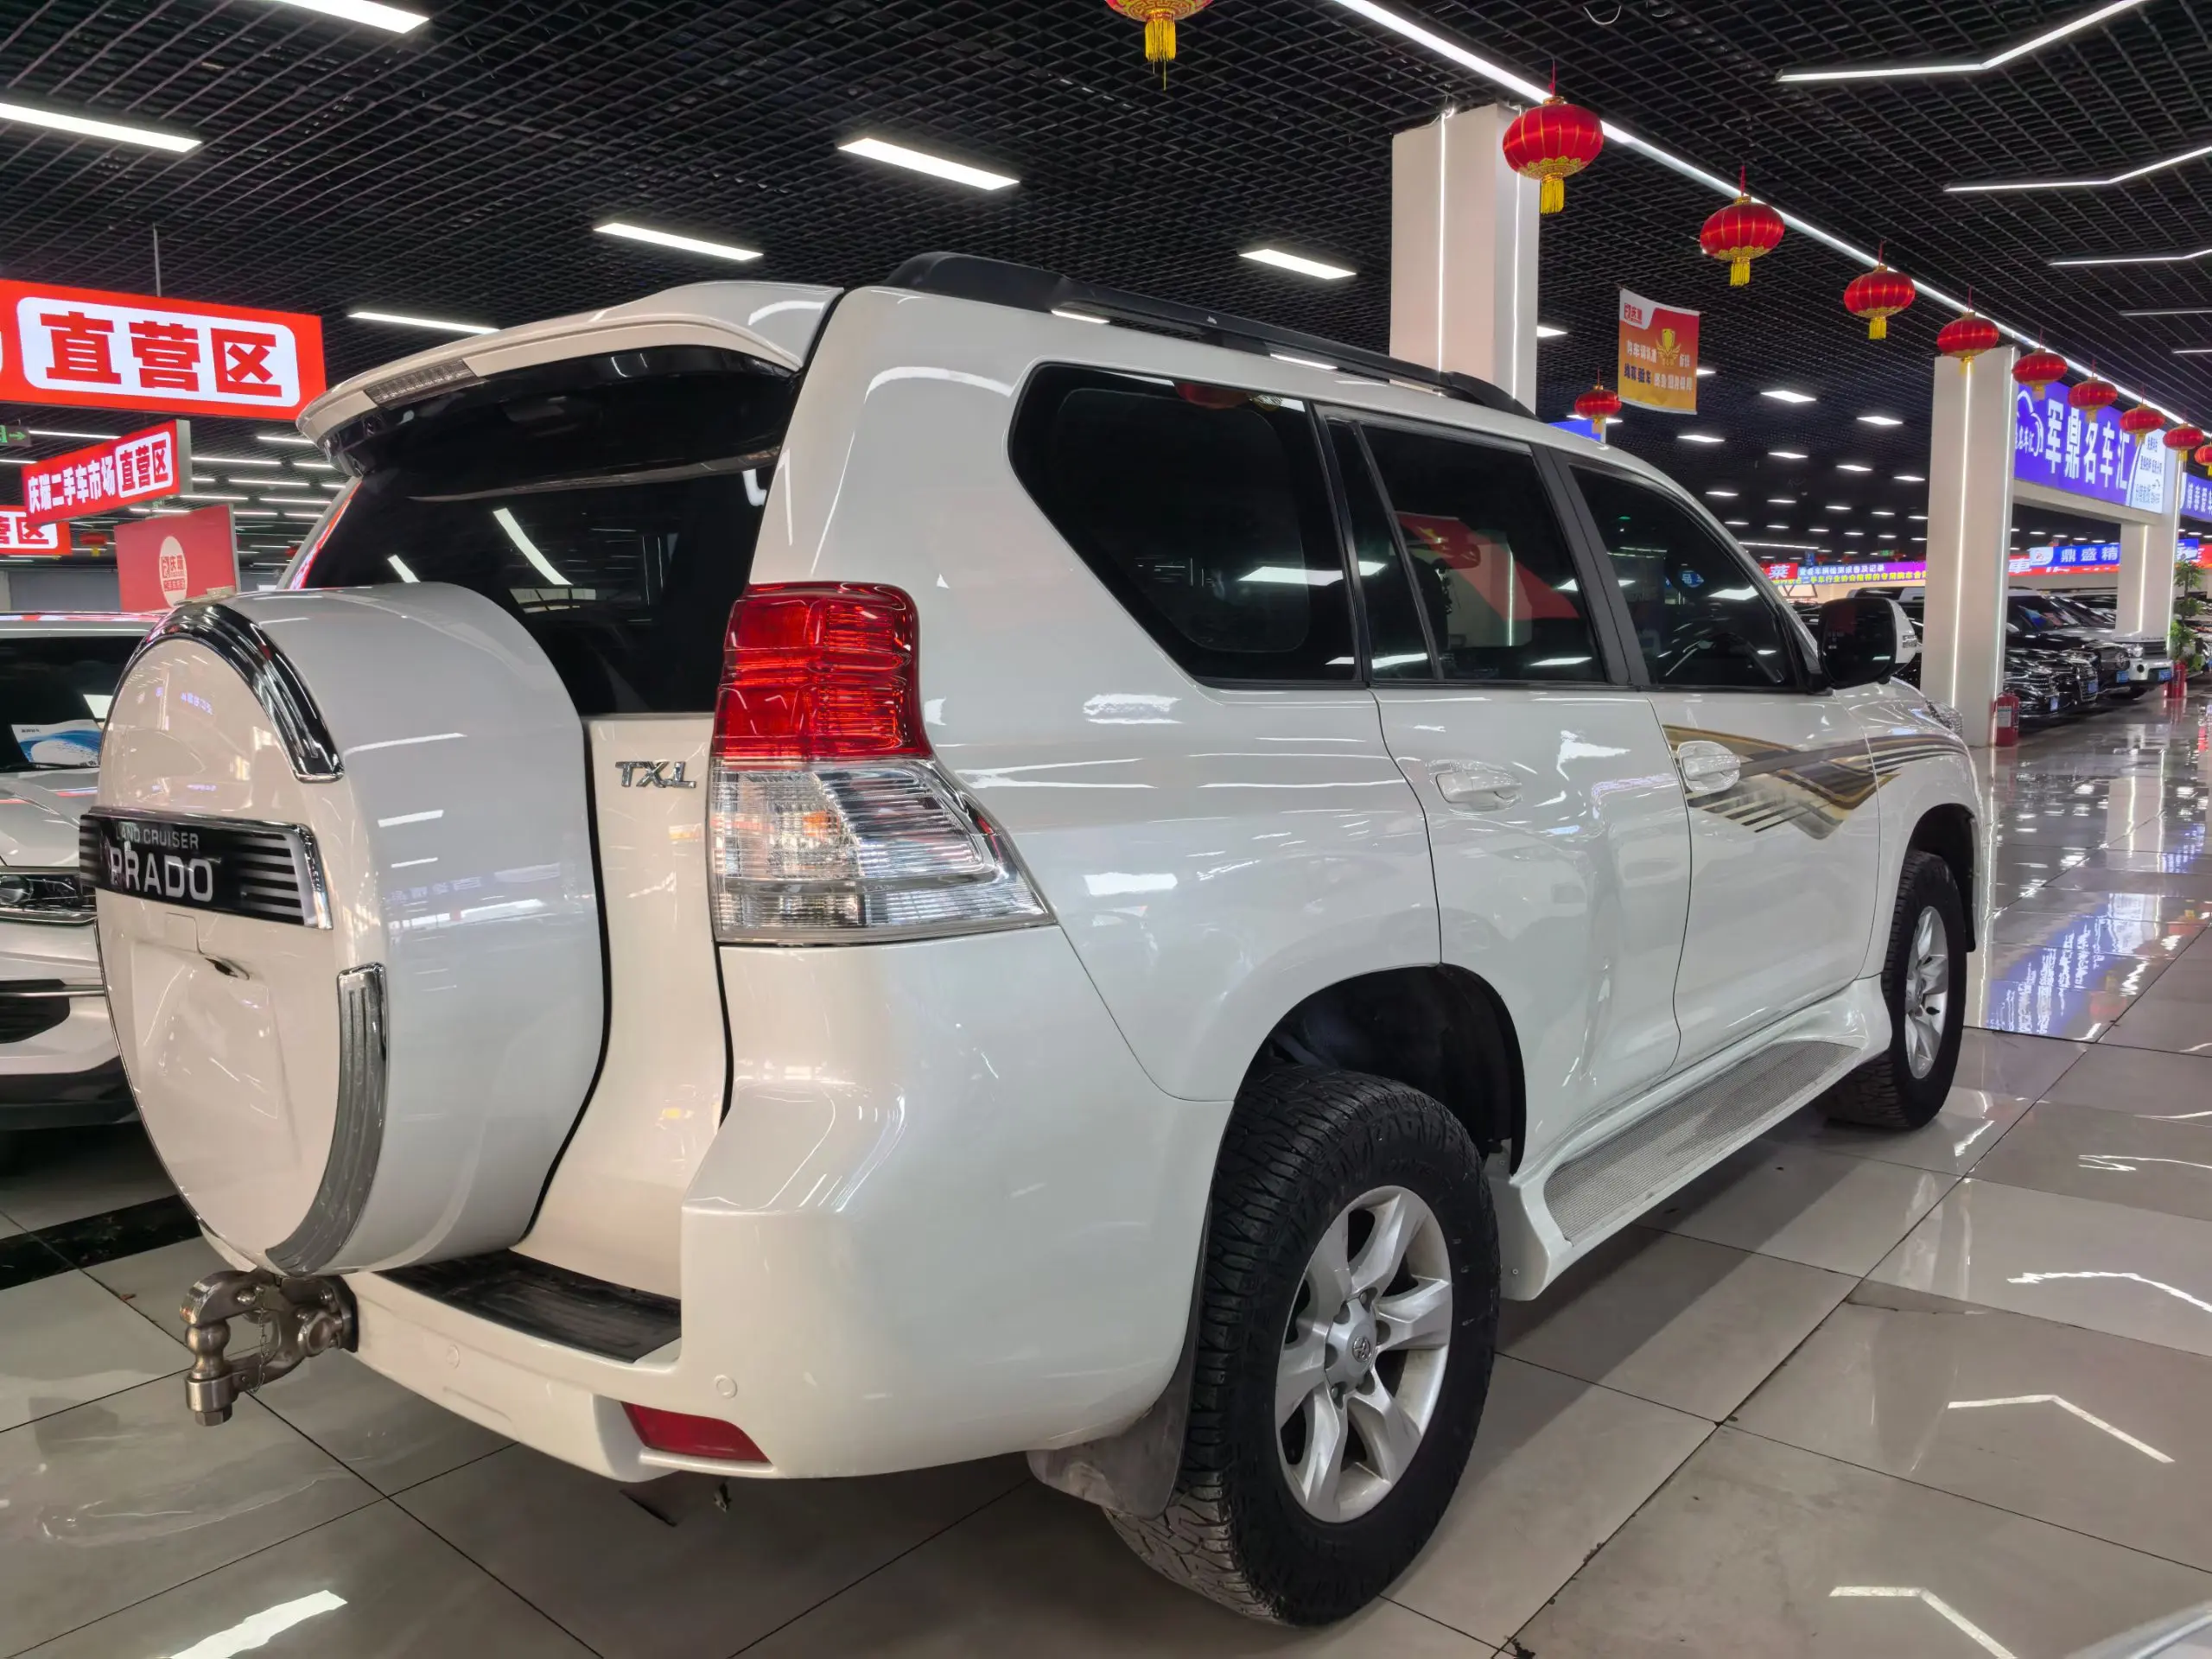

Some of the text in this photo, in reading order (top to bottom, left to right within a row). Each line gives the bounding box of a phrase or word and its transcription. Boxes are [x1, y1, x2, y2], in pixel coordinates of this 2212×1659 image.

[39, 311, 283, 397] 直营区
[119, 439, 169, 492] 直营区
[2045, 399, 2130, 490] 军鼎名车汇
[2060, 547, 2119, 563] 鼎盛精
[615, 760, 696, 788] TXL
[143, 830, 200, 850] CRUISER
[109, 846, 213, 902] PRADO
